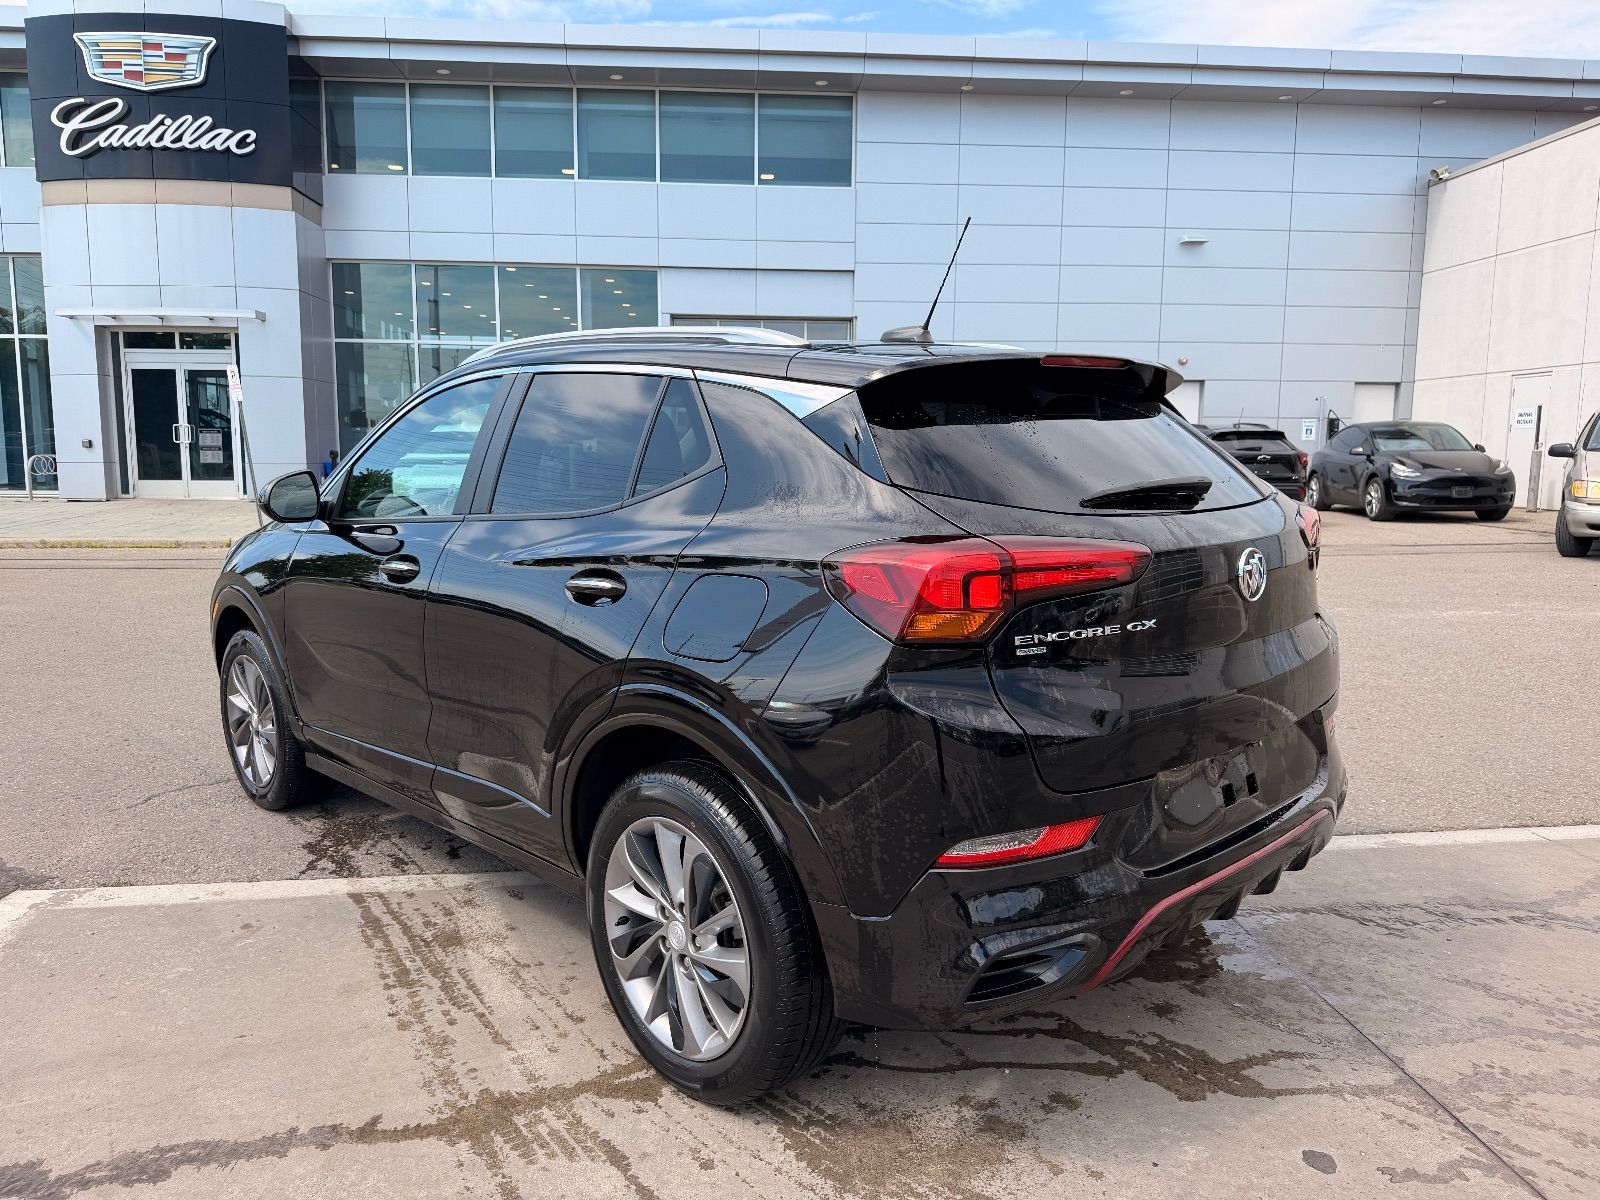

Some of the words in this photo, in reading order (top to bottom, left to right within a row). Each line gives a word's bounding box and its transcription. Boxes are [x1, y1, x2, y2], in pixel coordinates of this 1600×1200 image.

[50, 97, 257, 157] Cadillac
[1015, 625, 1121, 645] ENCORE
[1127, 619, 1156, 632] GX
